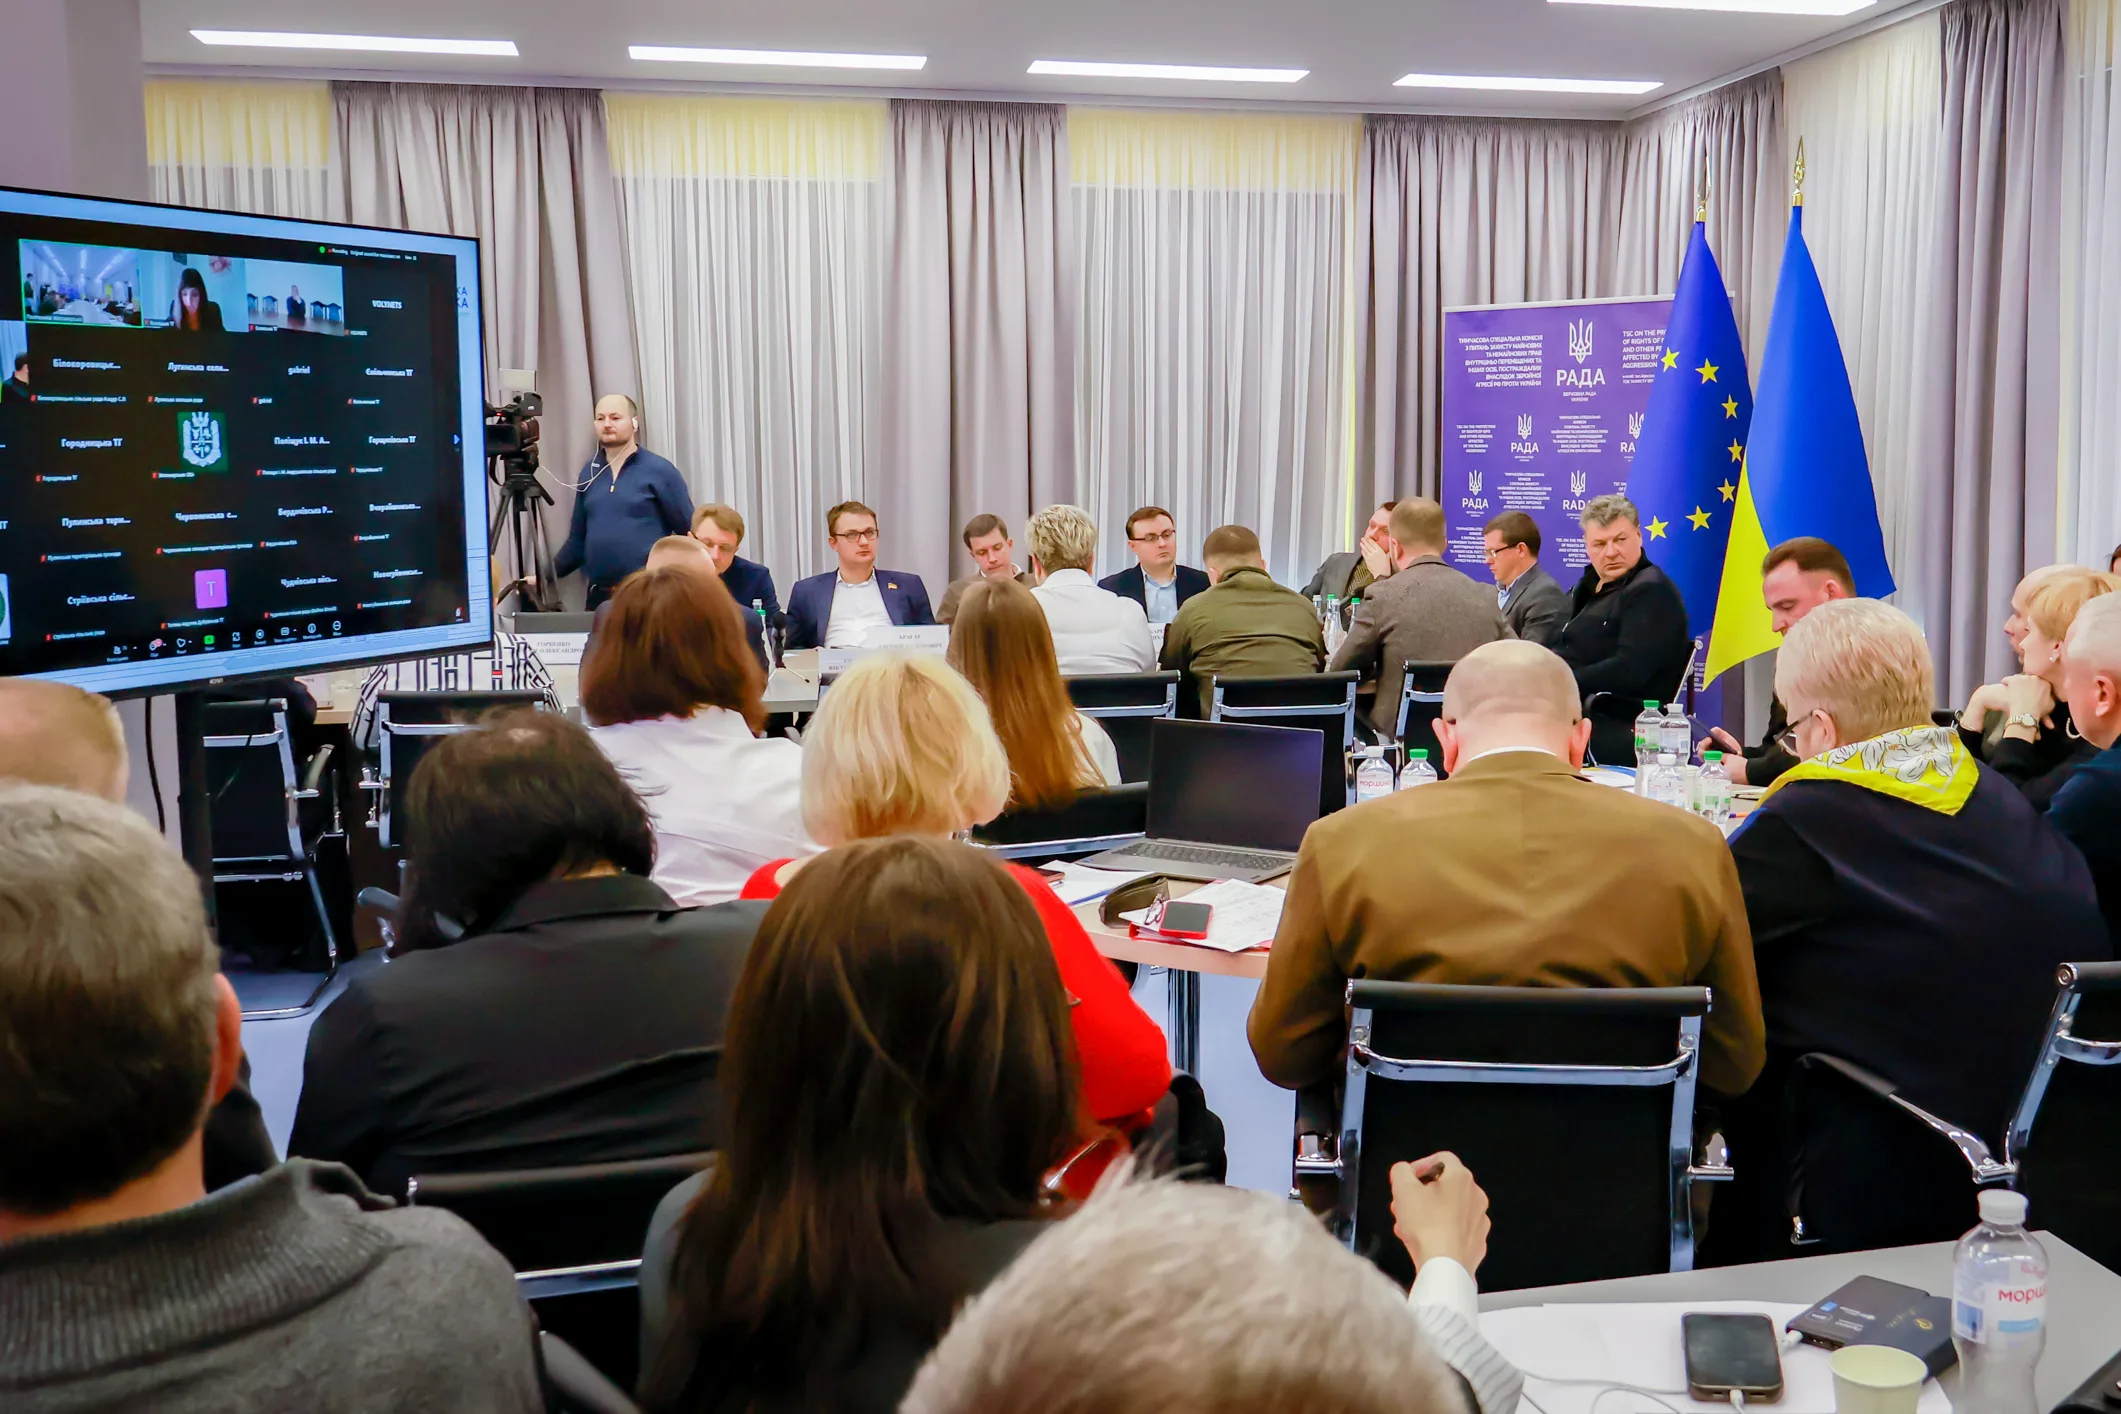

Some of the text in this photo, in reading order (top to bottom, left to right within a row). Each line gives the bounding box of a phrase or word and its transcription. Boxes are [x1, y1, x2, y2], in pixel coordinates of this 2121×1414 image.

[372, 300, 402, 309] VOLYNETS
[288, 366, 310, 375] gabriel
[1556, 368, 1606, 388] РАДА
[61, 438, 112, 449] Городницька
[274, 436, 304, 446] Поліщук
[1511, 442, 1539, 454] РАДА
[1462, 498, 1489, 509] РАДА
[1563, 500, 1590, 510] RAD
